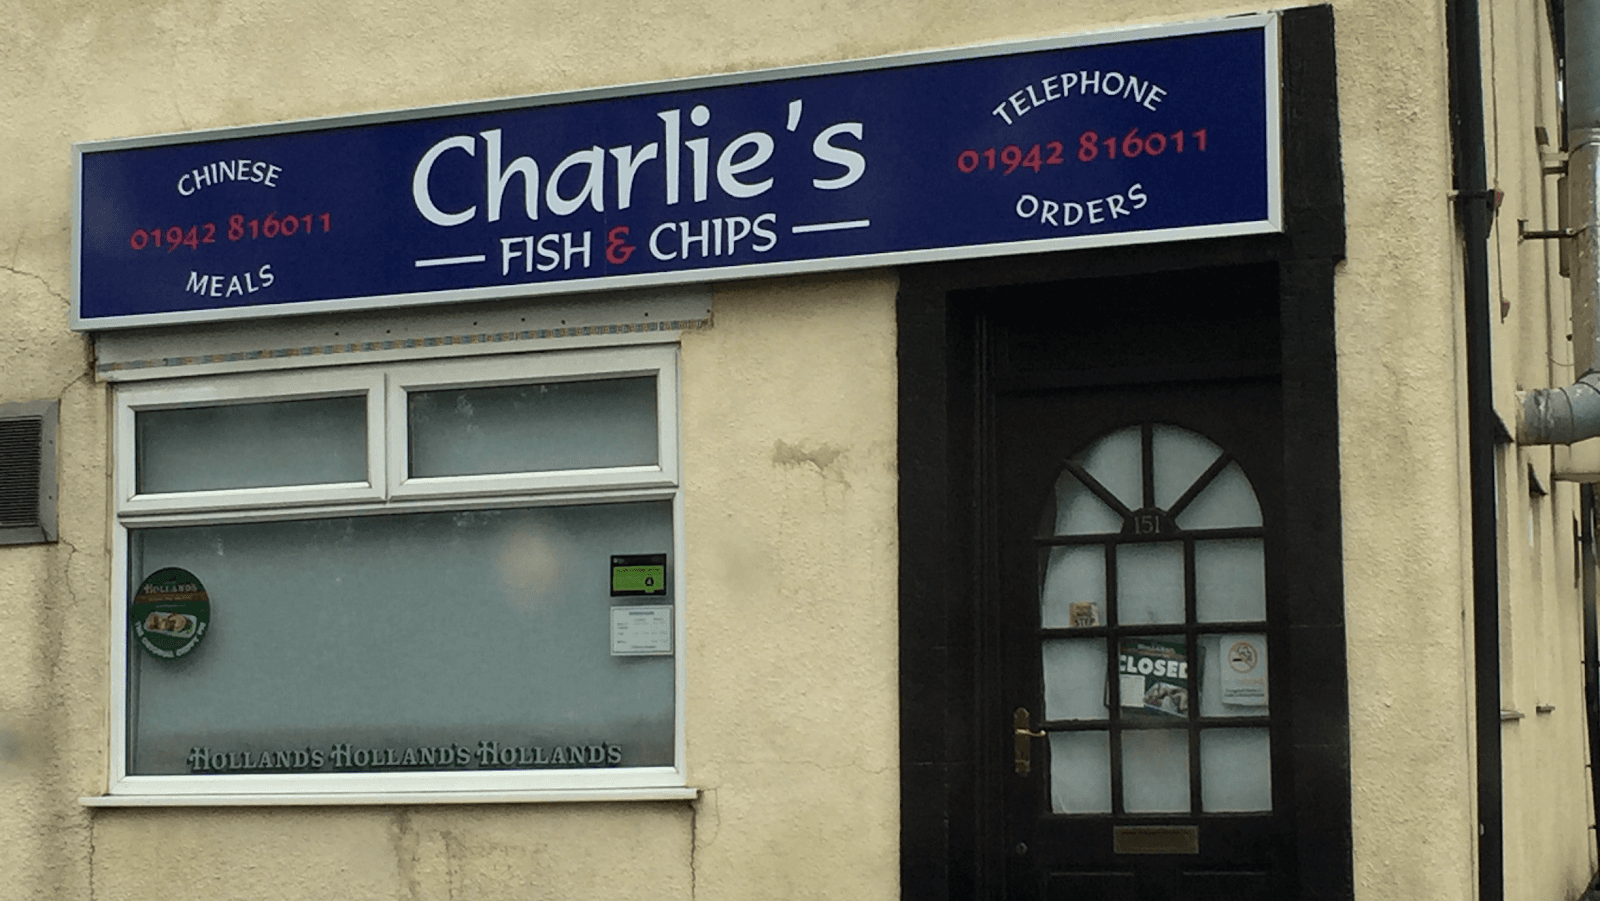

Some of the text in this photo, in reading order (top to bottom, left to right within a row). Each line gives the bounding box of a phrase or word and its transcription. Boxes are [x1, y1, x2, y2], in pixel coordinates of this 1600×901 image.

[992, 70, 1168, 126] TELEPHONE
[412, 99, 867, 227] Charlie's
[957, 127, 1208, 176] 01942 816011
[177, 159, 283, 196] CHINESE
[1016, 183, 1148, 227] ORDERS
[130, 211, 331, 252] 01942 816011
[500, 213, 778, 276] FISH & CHIPS
[185, 264, 275, 298] MEALS
[1134, 515, 1160, 535] 151
